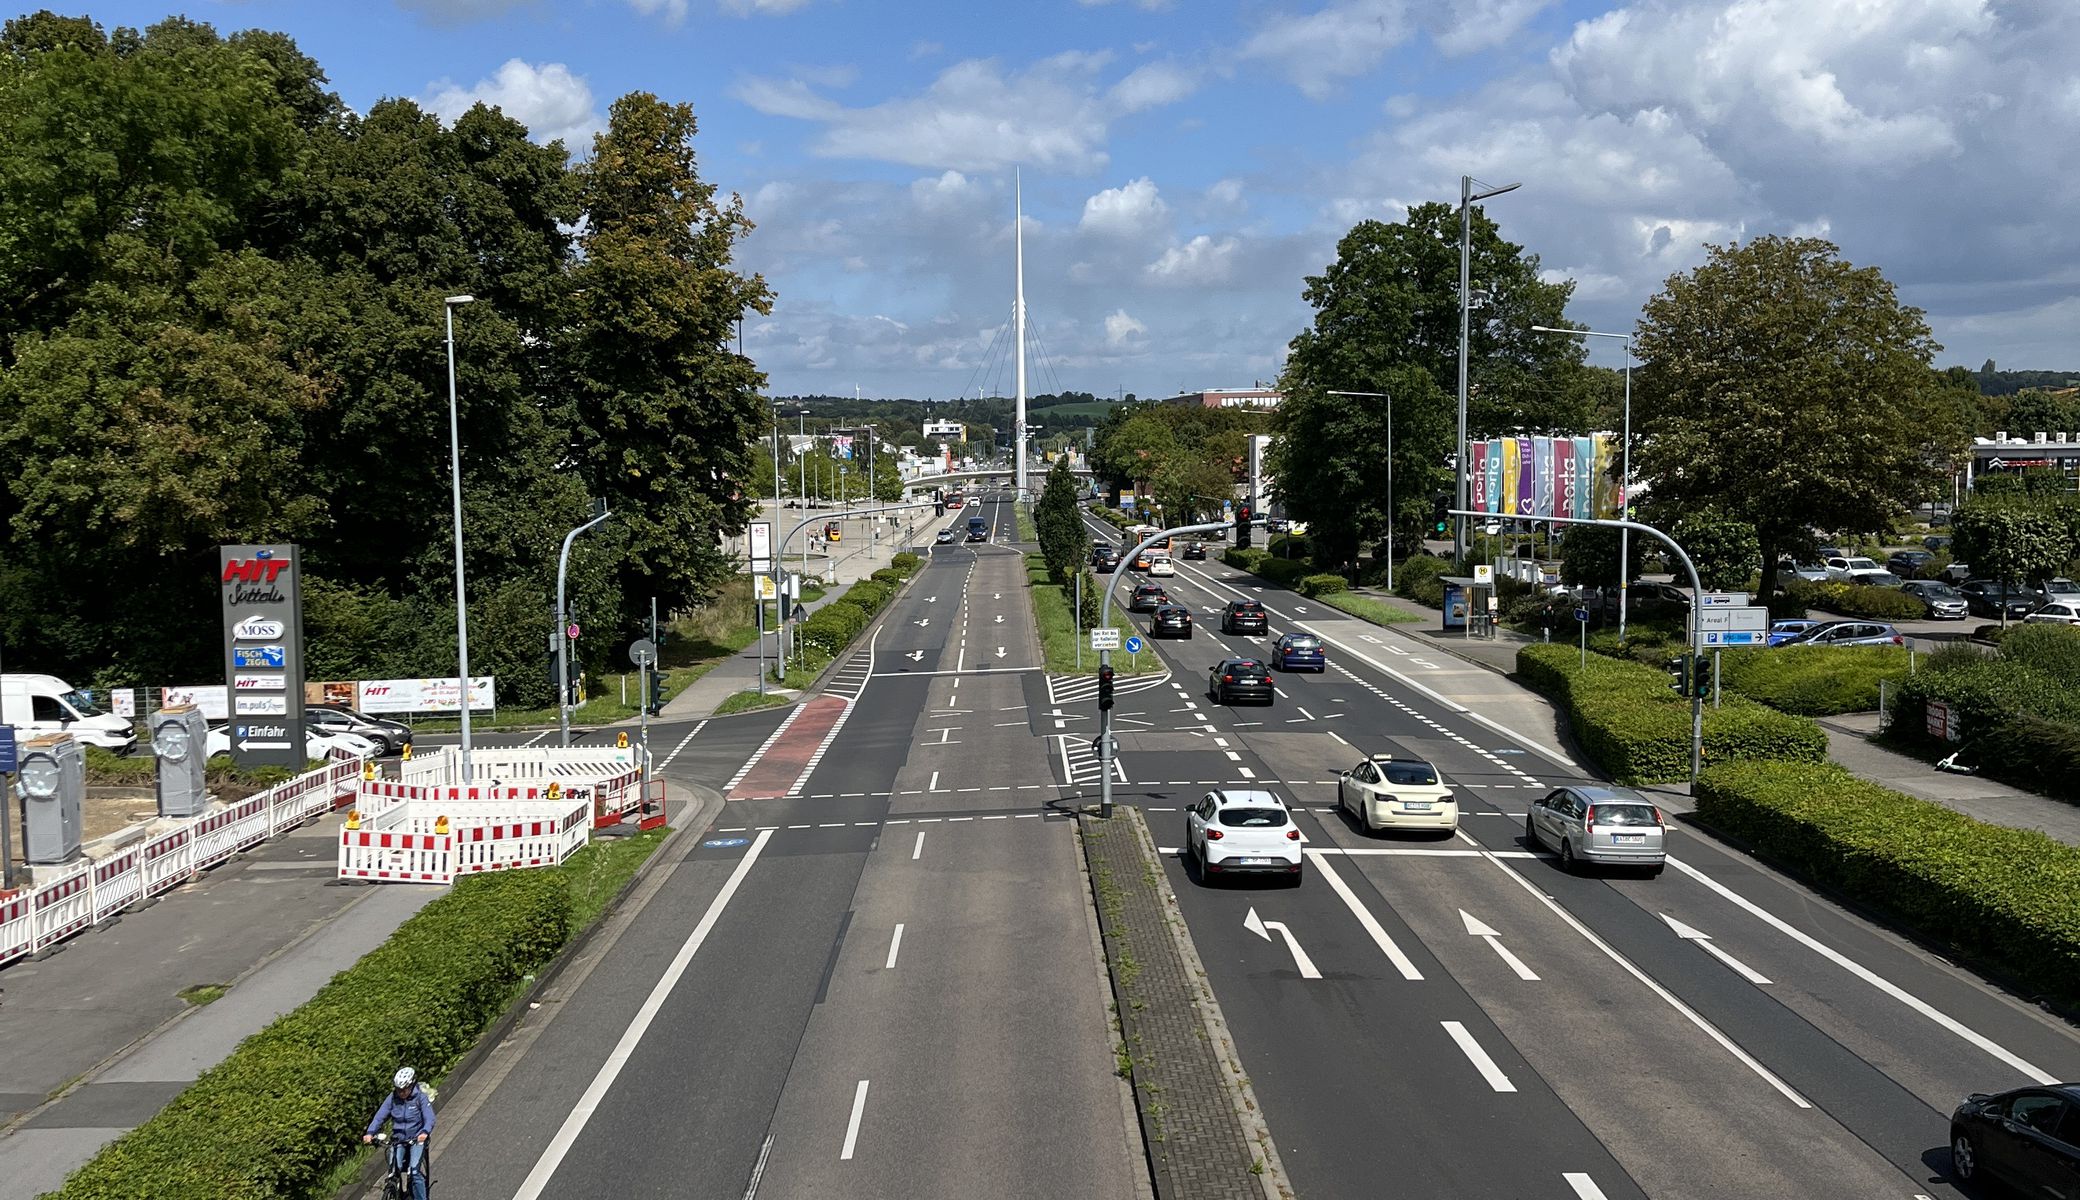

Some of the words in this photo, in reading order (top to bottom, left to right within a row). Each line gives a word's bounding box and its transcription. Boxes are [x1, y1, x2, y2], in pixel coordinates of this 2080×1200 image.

[1475, 458, 1485, 504] porta
[222, 559, 290, 582] HIT
[241, 625, 275, 636] MOSS
[236, 650, 263, 658] FISCH
[245, 658, 271, 667] ZEGEL
[236, 679, 258, 688] HIT
[365, 686, 391, 696] HIT
